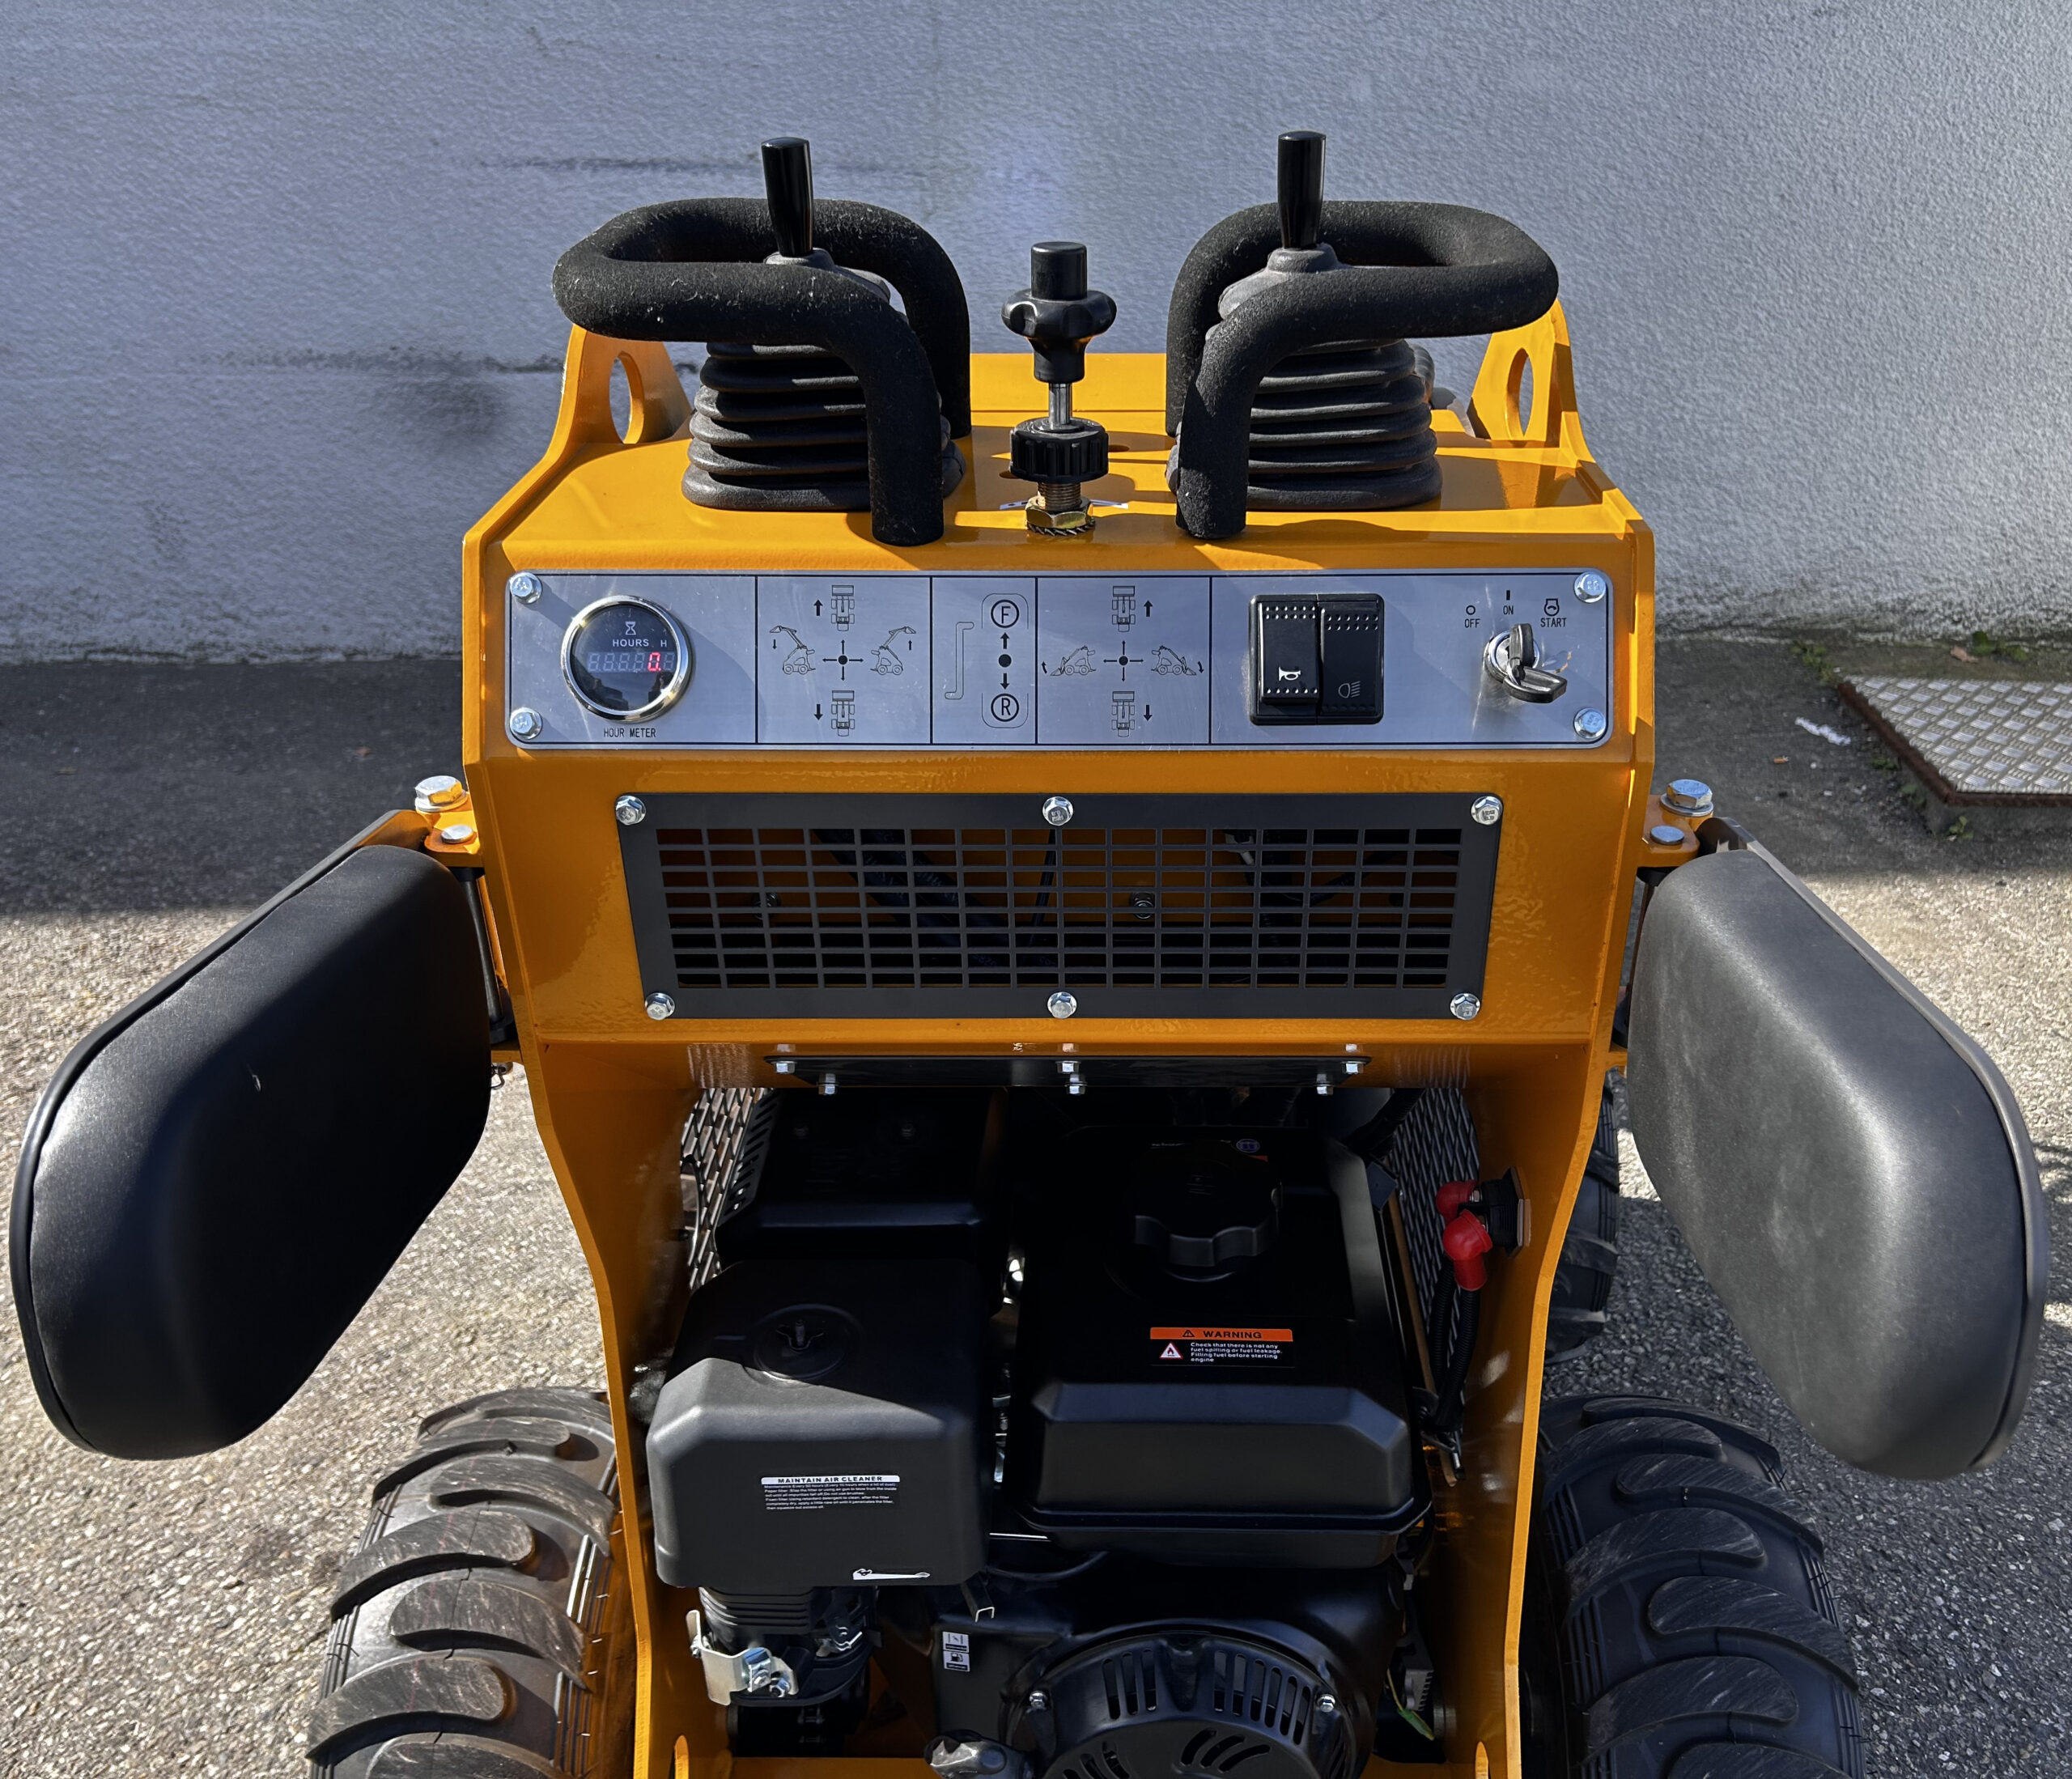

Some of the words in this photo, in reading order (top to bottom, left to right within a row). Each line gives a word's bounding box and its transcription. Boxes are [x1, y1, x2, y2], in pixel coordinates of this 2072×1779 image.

[1000, 605, 1011, 624] F
[1503, 605, 1514, 615] ON
[1464, 618, 1480, 628] OFF
[1540, 618, 1567, 627] START
[612, 639, 649, 647] HOURS
[1001, 698, 1011, 716] R
[604, 728, 625, 738] HOUR
[630, 728, 656, 738] METER
[1203, 1331, 1263, 1339] WARNING
